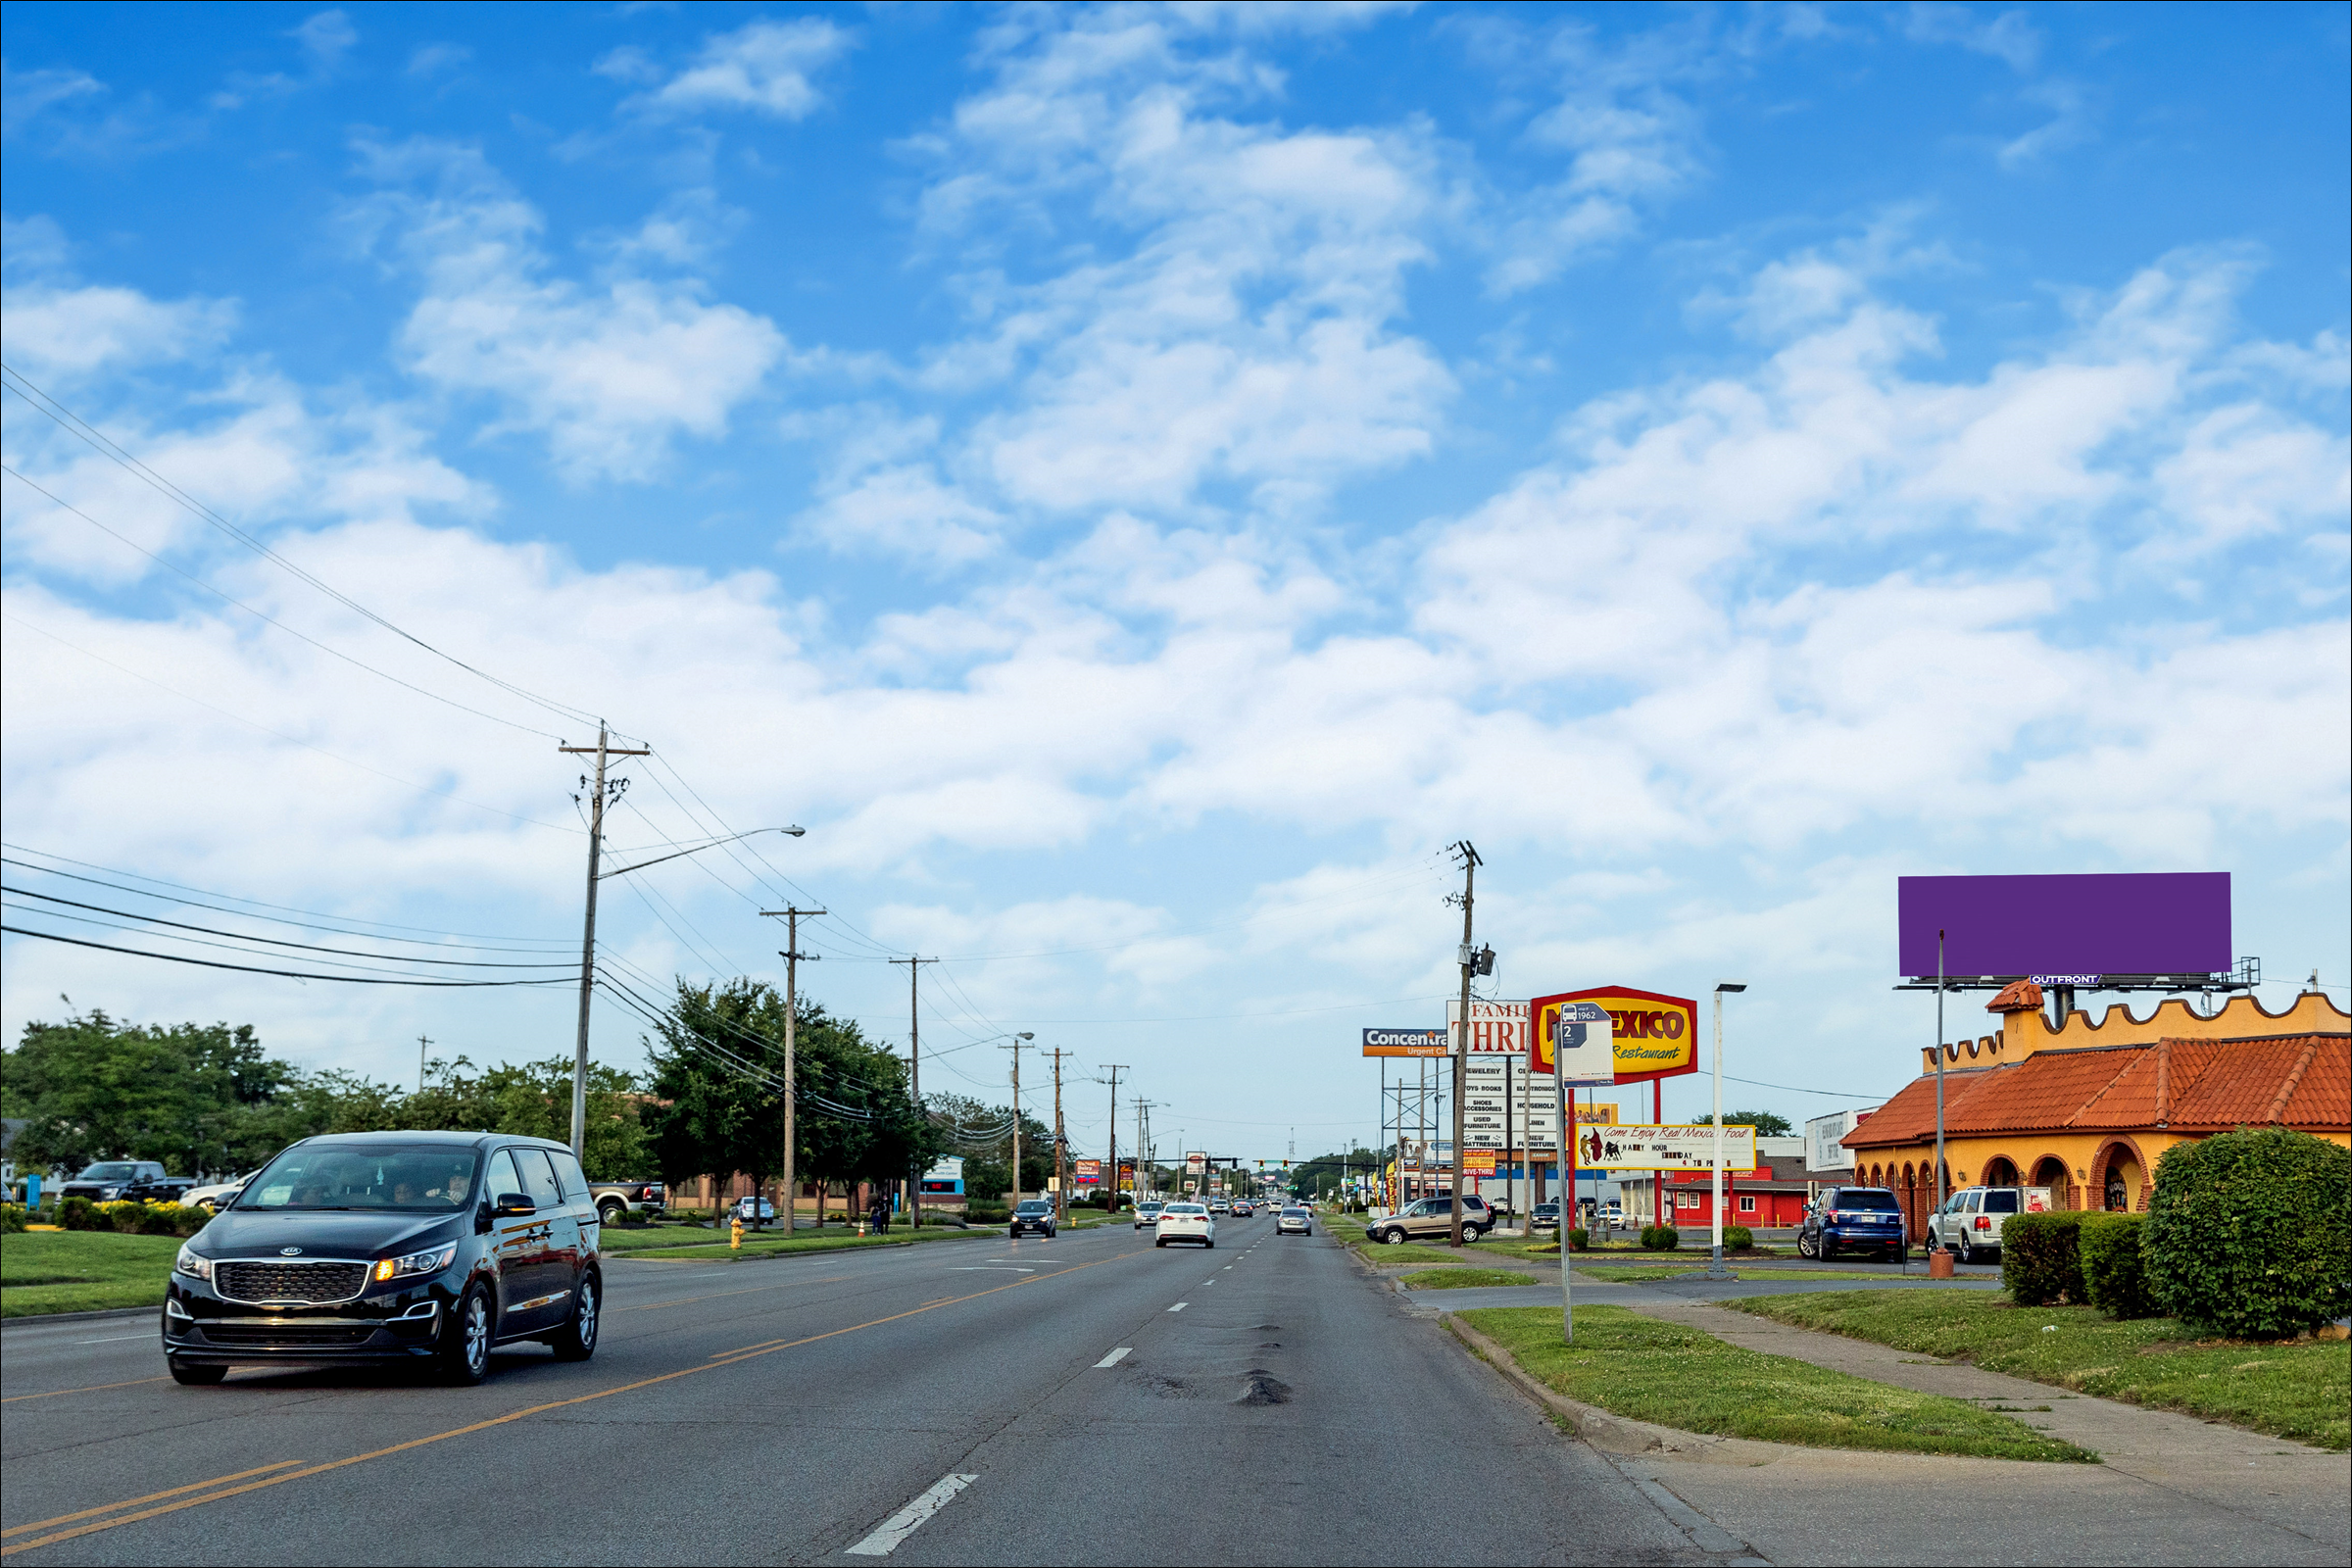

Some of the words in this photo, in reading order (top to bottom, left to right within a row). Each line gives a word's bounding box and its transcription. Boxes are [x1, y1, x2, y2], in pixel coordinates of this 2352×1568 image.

[2032, 975, 2098, 984] OUTFRONT
[1563, 1025, 1572, 1038] 2
[1407, 1048, 1435, 1056] Urgent
[1612, 1045, 1681, 1059] Restaurant
[1604, 1127, 1628, 1138] Come
[1631, 1127, 1657, 1142] Enjoy
[1659, 1127, 1682, 1138] Real
[1724, 1127, 1749, 1139] Food!
